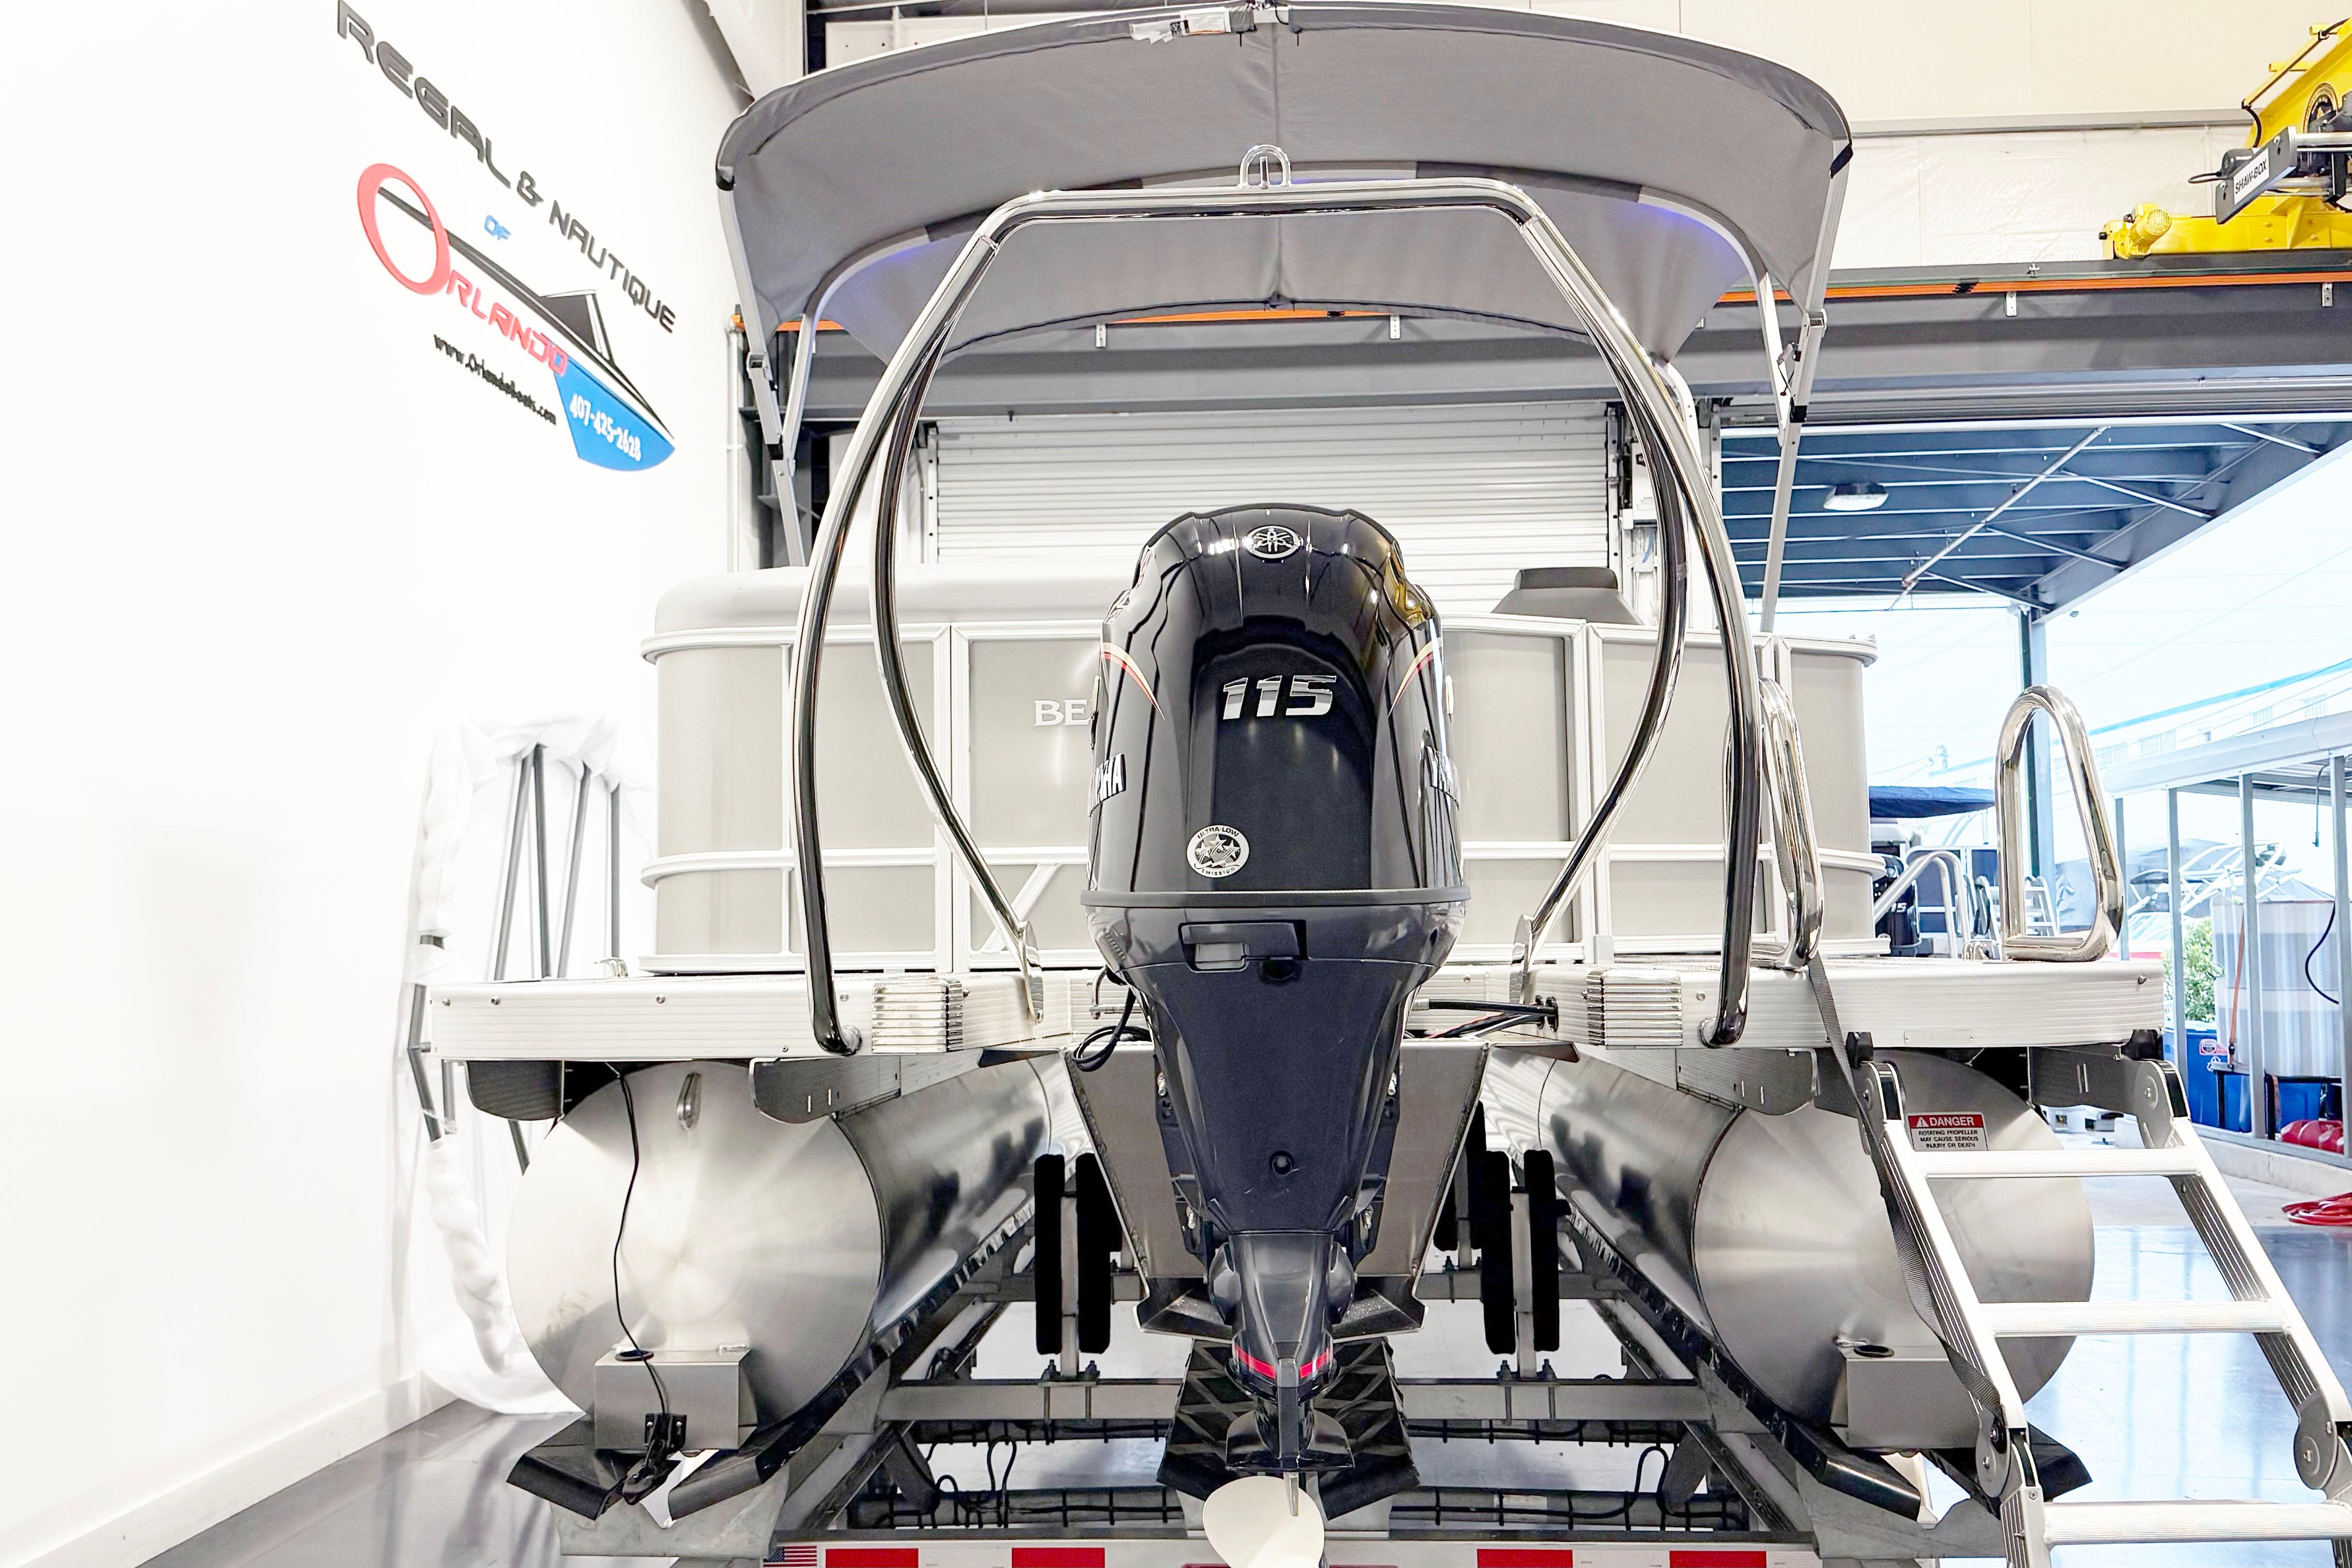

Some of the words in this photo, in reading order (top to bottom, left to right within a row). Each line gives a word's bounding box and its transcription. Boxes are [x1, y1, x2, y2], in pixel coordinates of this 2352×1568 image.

[337, 0, 511, 189] REGAL
[517, 171, 544, 207] &
[549, 199, 675, 334] NAUTIQUE
[2235, 159, 2267, 194] SHAW-BOX
[484, 215, 511, 241] OF
[357, 163, 568, 376] ORLANDO
[569, 393, 642, 461] 407-425-2628
[1223, 675, 1337, 720] 115
[1929, 1117, 1975, 1126] DANGER
